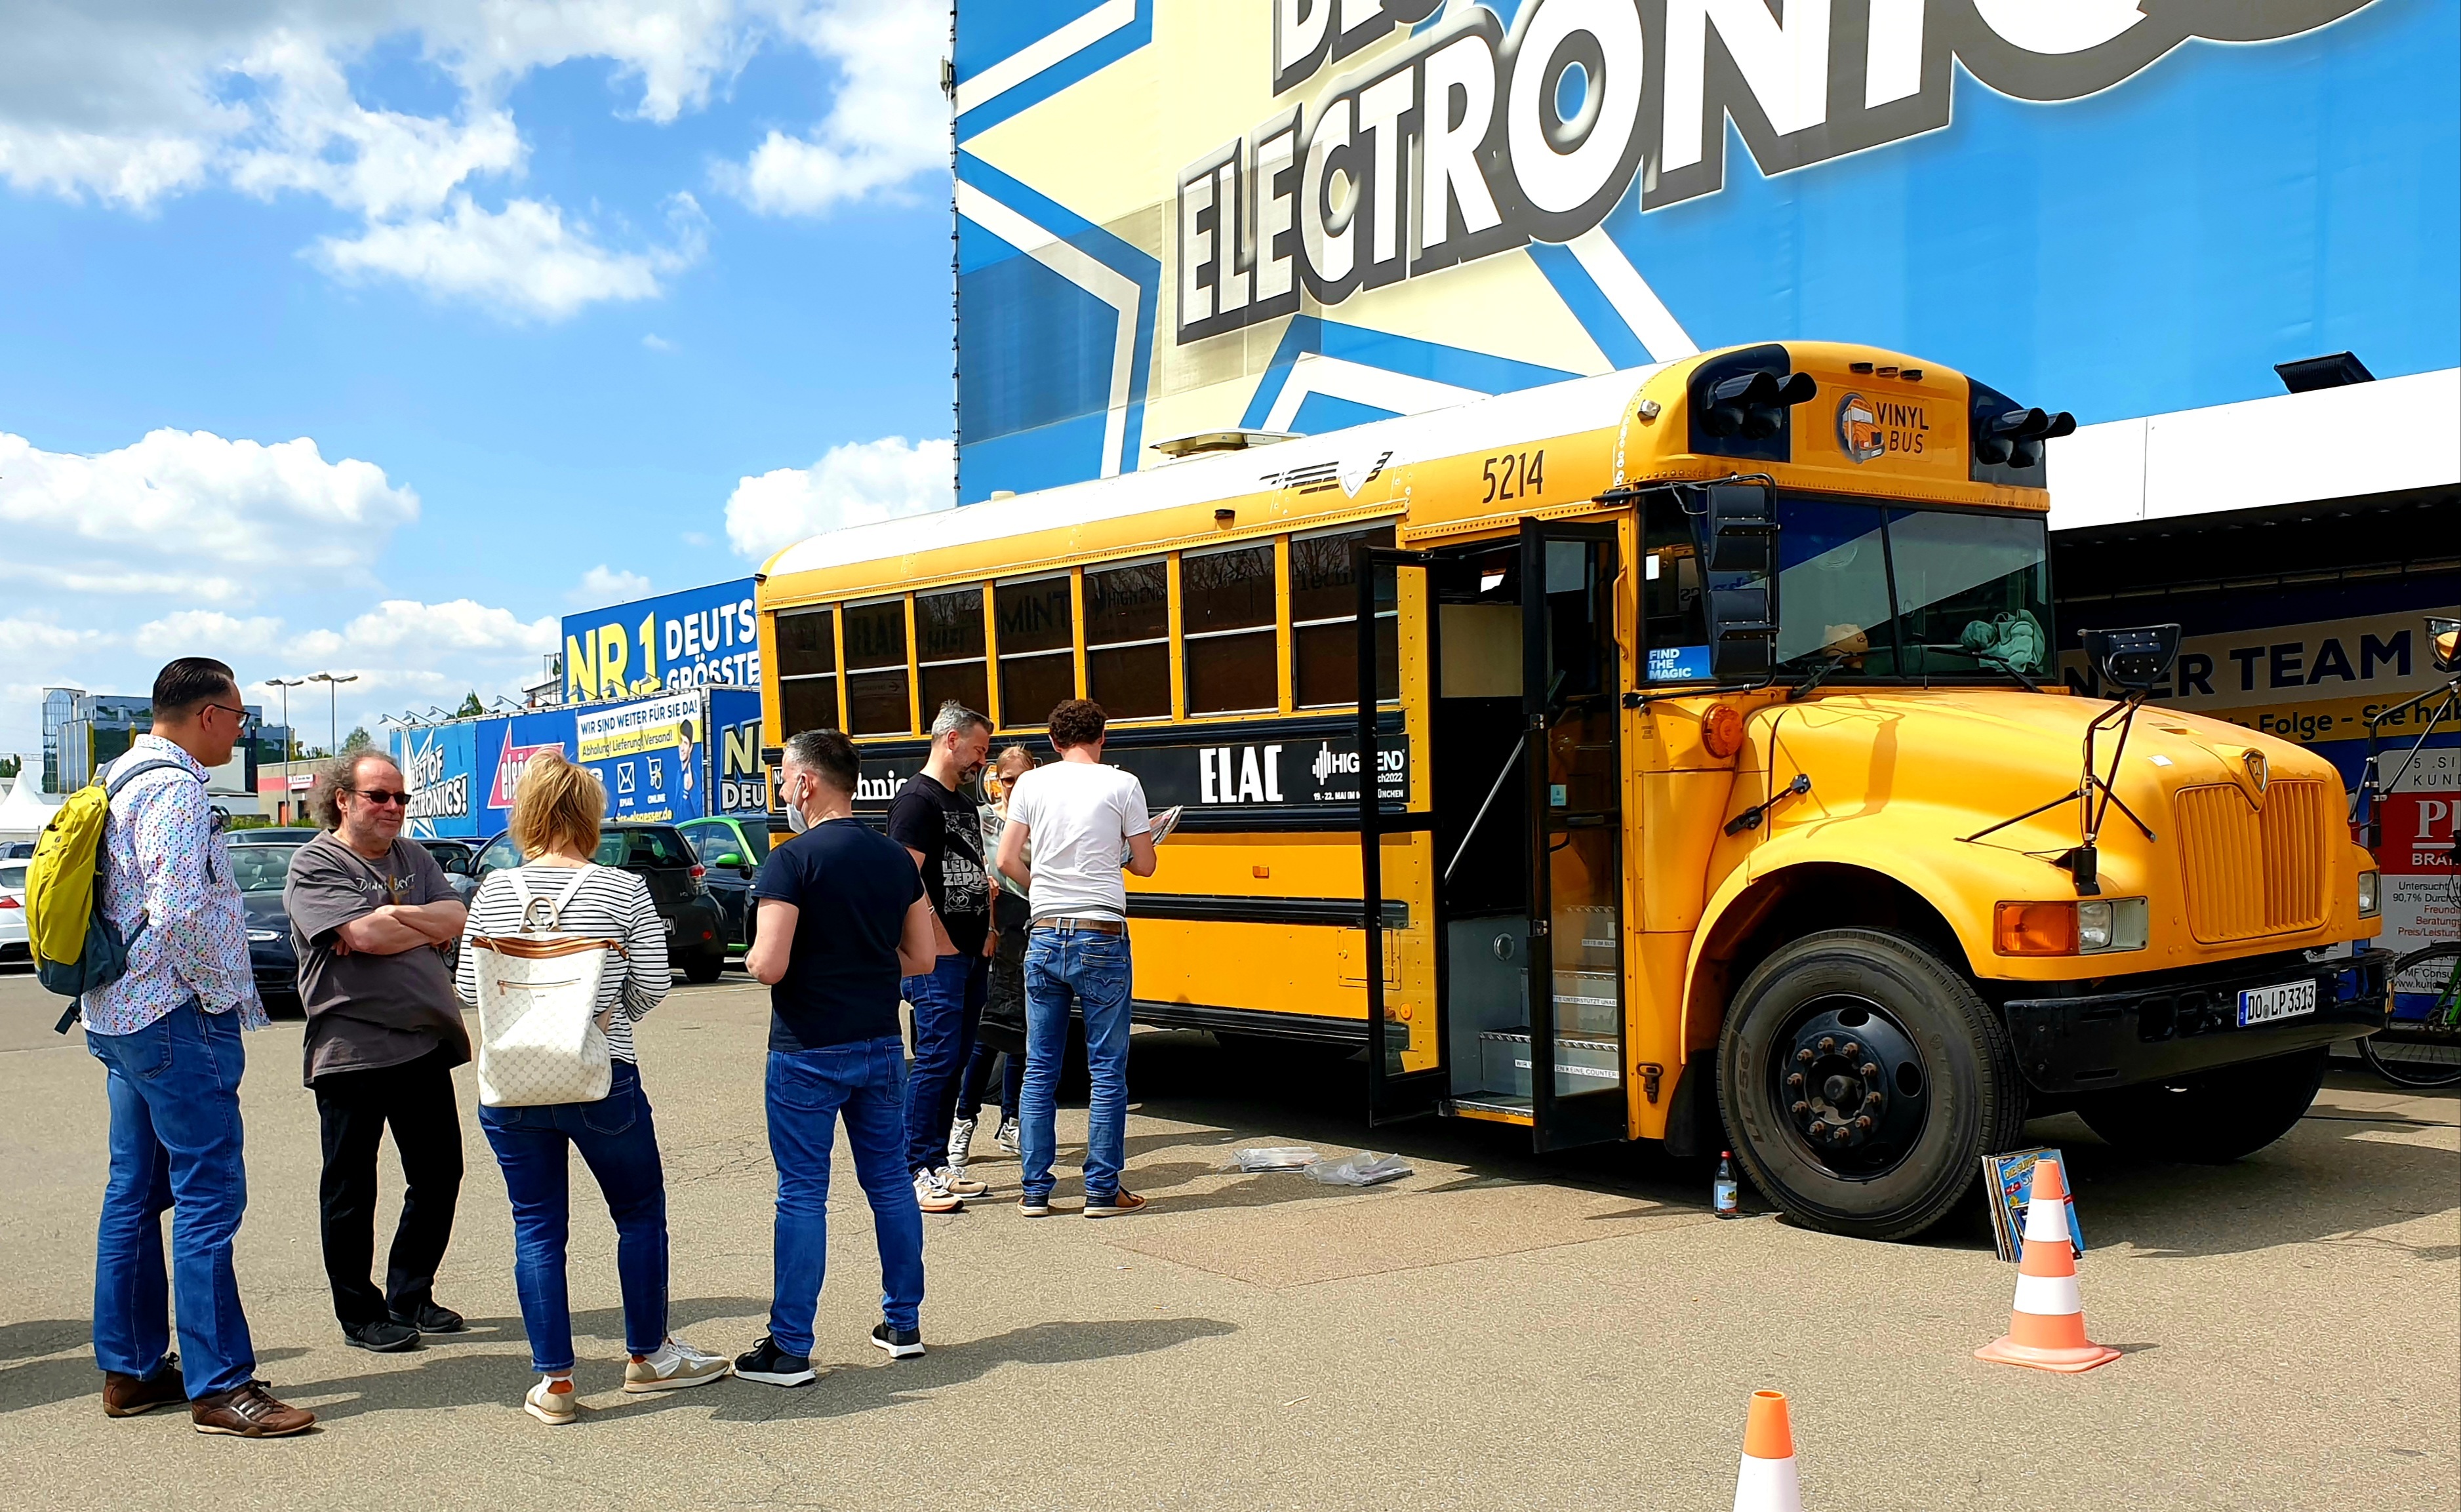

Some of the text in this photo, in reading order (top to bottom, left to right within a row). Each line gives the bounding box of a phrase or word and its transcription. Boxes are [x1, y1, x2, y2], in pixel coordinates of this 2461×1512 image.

[1875, 401, 1929, 431] VINYL
[1889, 430, 1923, 454] BUS
[1483, 449, 1543, 504] 5214
[665, 598, 756, 662] DEUTS
[1649, 648, 1680, 660] FIND
[1649, 659, 1674, 669] THE
[2228, 629, 2412, 692] TEAM
[1649, 667, 1692, 679] MAGIC
[581, 700, 698, 735] WIR SIND WEITER FÜR SIE DA!
[2259, 711, 2333, 740] Folge
[2362, 704, 2406, 727] Sie
[582, 740, 612, 757] Abholung!
[645, 730, 673, 746] Versand!
[428, 746, 443, 786] OF
[1199, 745, 1283, 803] ELAC
[722, 782, 765, 809] DEU
[1378, 788, 1403, 798] ÜNCHEN
[942, 860, 972, 873] LED
[2393, 893, 2422, 903] 90,7%
[2248, 994, 2262, 1020] DO
[2271, 990, 2286, 1016] LP
[2288, 984, 2314, 1012] 3313
[1566, 1066, 1585, 1075] KEINE
